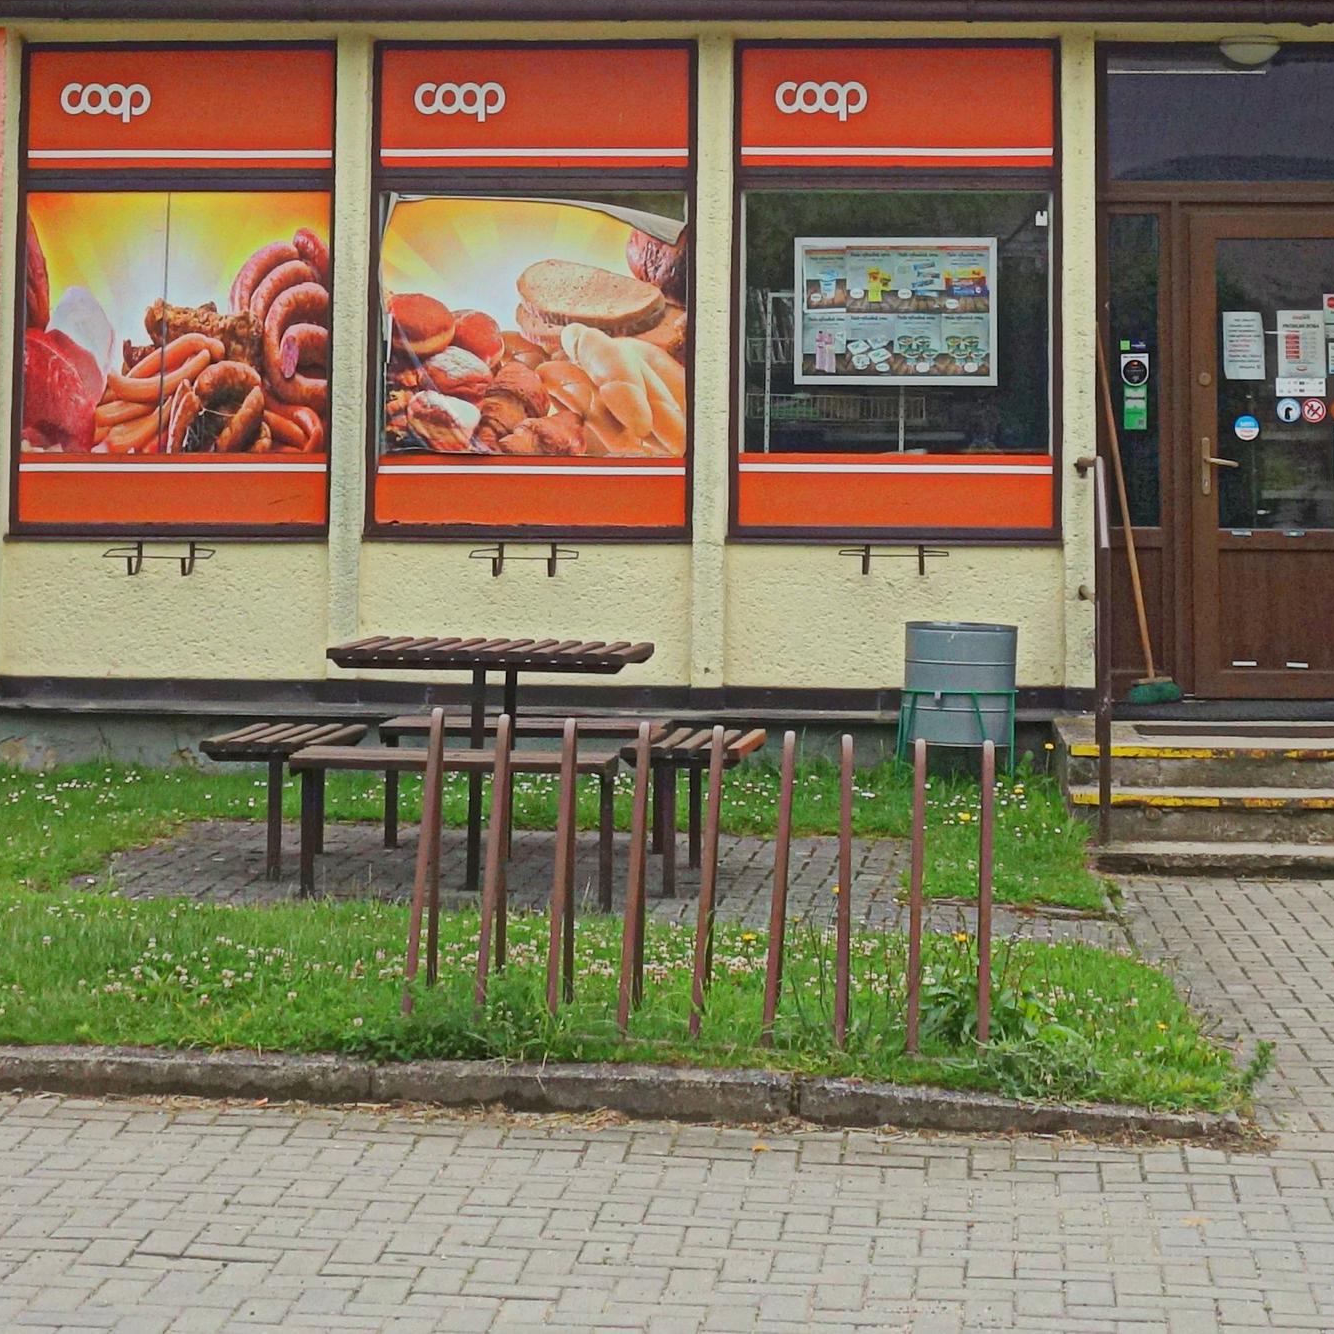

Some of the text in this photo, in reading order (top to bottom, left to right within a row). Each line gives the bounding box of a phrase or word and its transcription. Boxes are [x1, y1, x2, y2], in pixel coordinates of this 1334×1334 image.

[60, 82, 152, 123] coop
[414, 81, 506, 123] coop
[775, 81, 868, 122] coop
